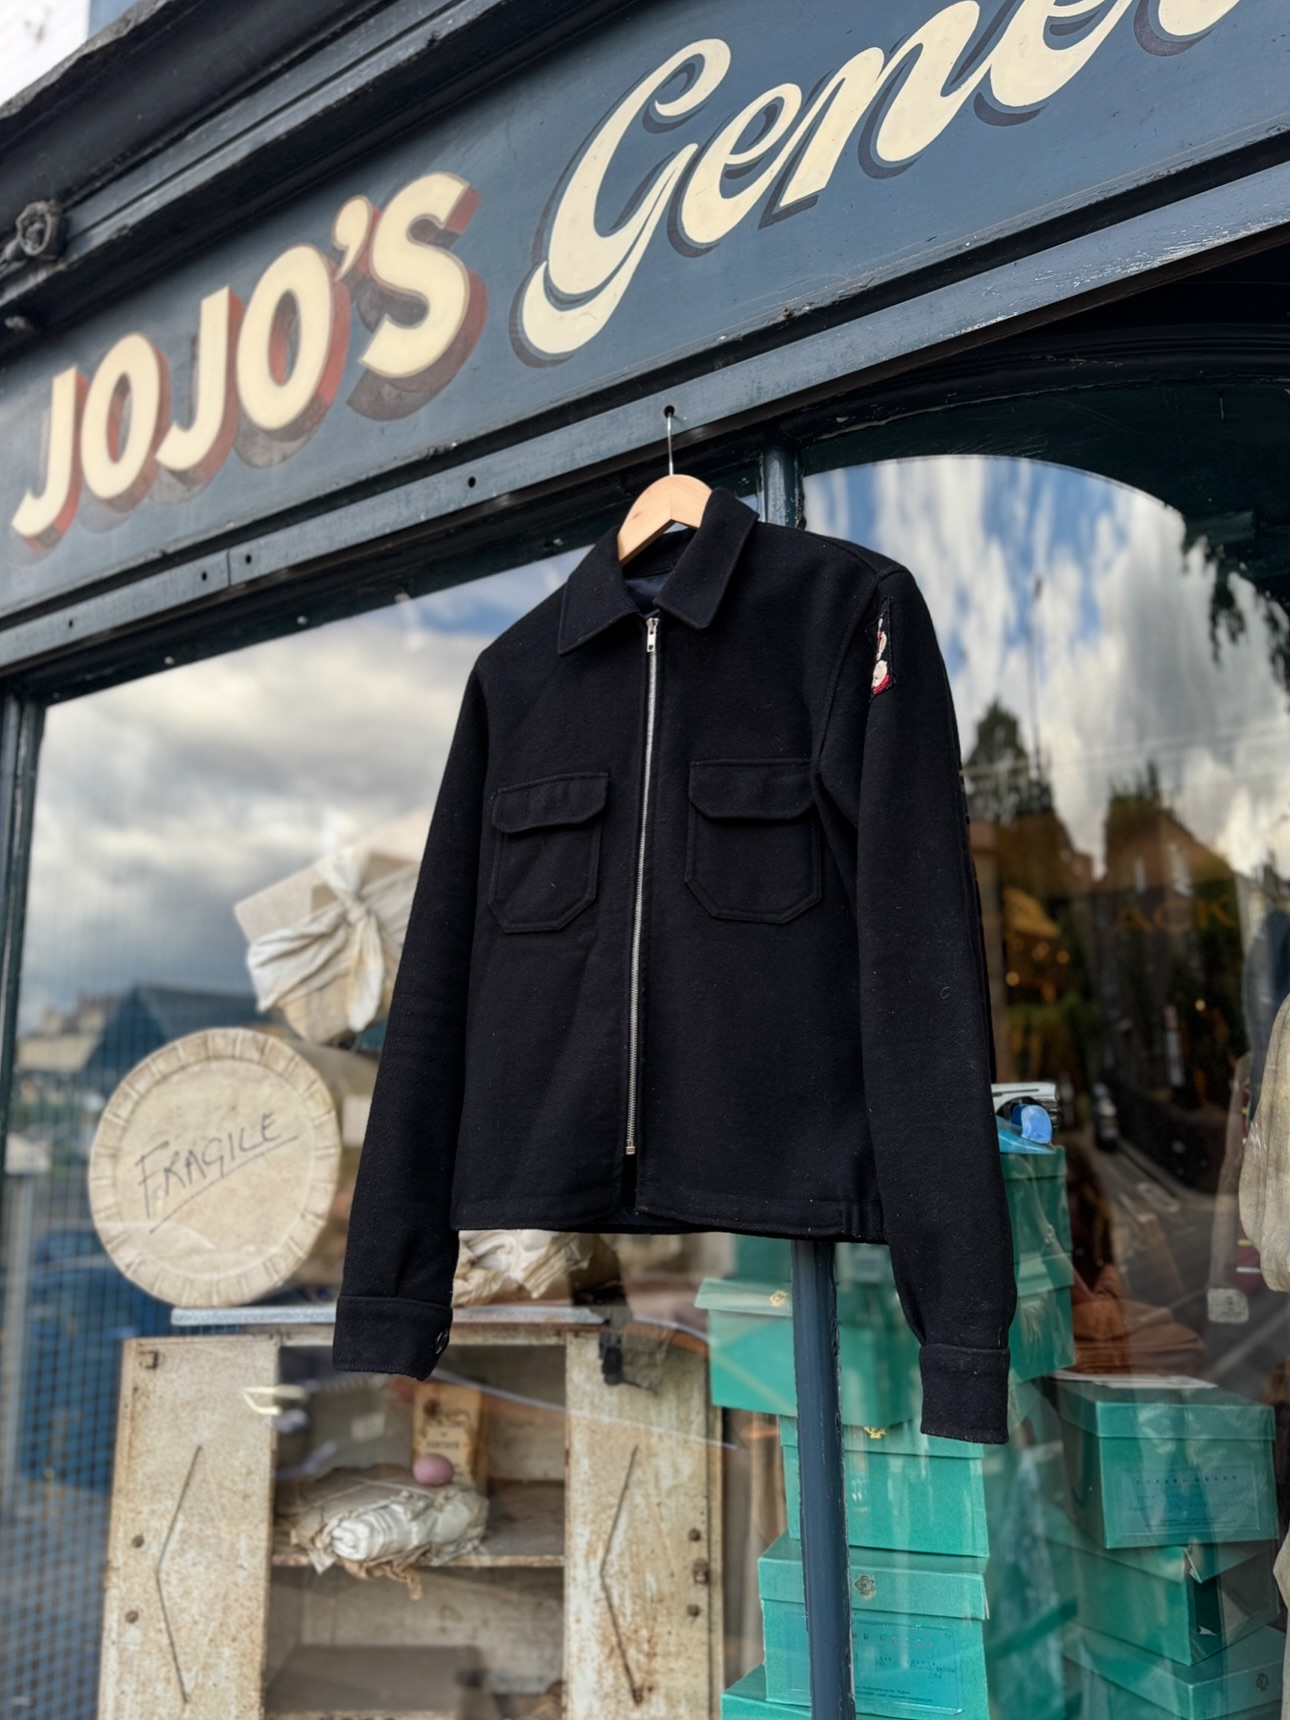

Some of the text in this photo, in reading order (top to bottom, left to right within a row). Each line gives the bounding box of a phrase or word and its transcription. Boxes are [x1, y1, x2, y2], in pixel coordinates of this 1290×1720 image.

[11, 0, 1242, 541] JOJO'S Gene
[135, 1112, 282, 1220] FRAGILE
